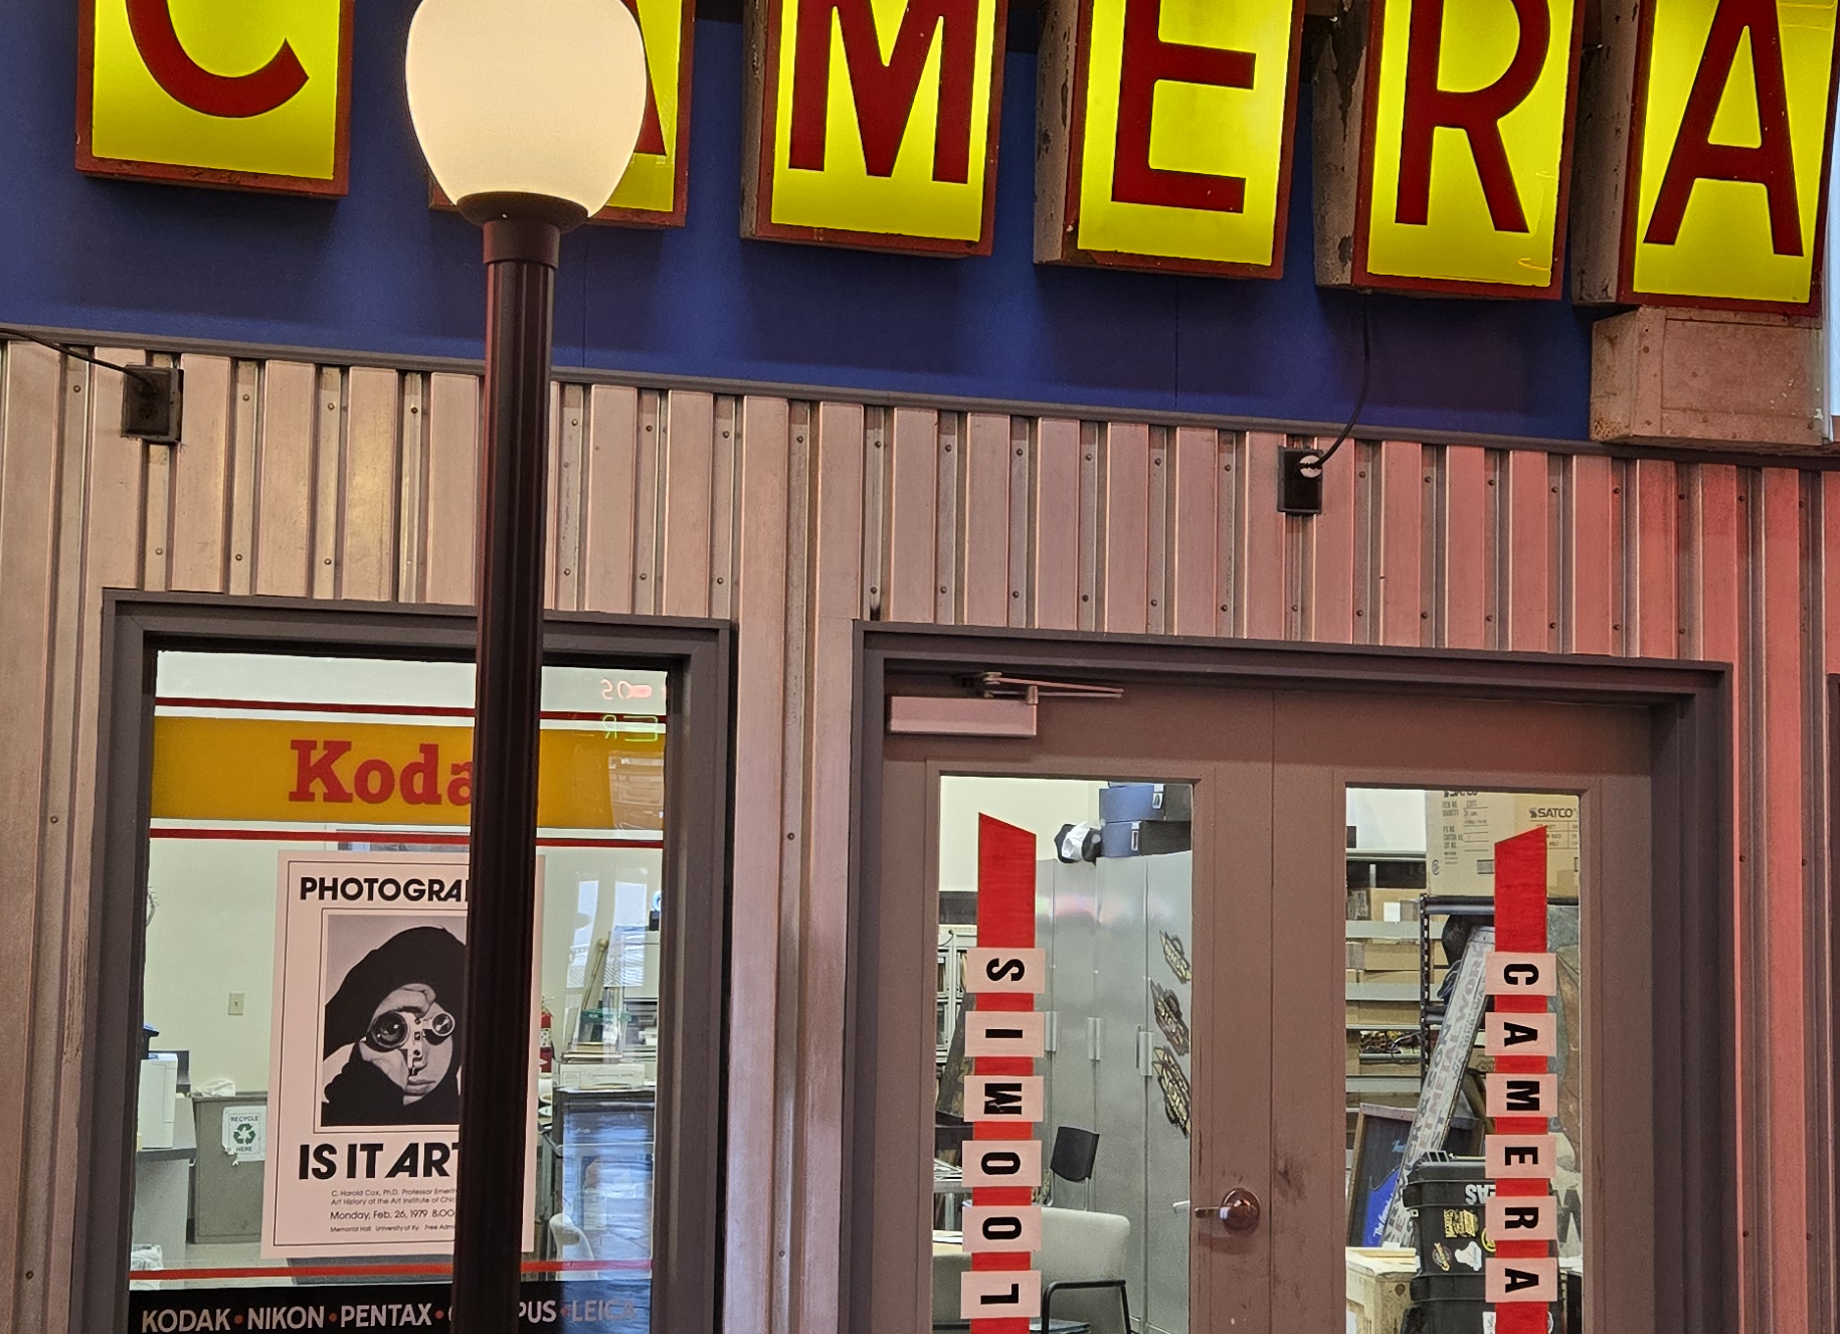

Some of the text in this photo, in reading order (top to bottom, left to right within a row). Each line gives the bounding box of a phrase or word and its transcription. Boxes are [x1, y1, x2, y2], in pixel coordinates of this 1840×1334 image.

[288, 739, 472, 807] Koda
[1537, 807, 1573, 818] SATCO
[300, 876, 470, 902] PHOTOGRA
[979, 957, 1026, 1305] LOOMIS
[1503, 962, 1540, 1294] CAMERA
[299, 1143, 338, 1180] IS
[347, 1142, 384, 1179] IT
[340, 1189, 364, 1197] Harold
[330, 1211, 371, 1221] Monday,
[373, 1210, 392, 1219] Feb.
[410, 1209, 428, 1218] 1979
[141, 1308, 231, 1334] KODAK
[247, 1305, 325, 1330] NIKON
[340, 1302, 432, 1328] PENTAX
[571, 1299, 636, 1322] LEICA
